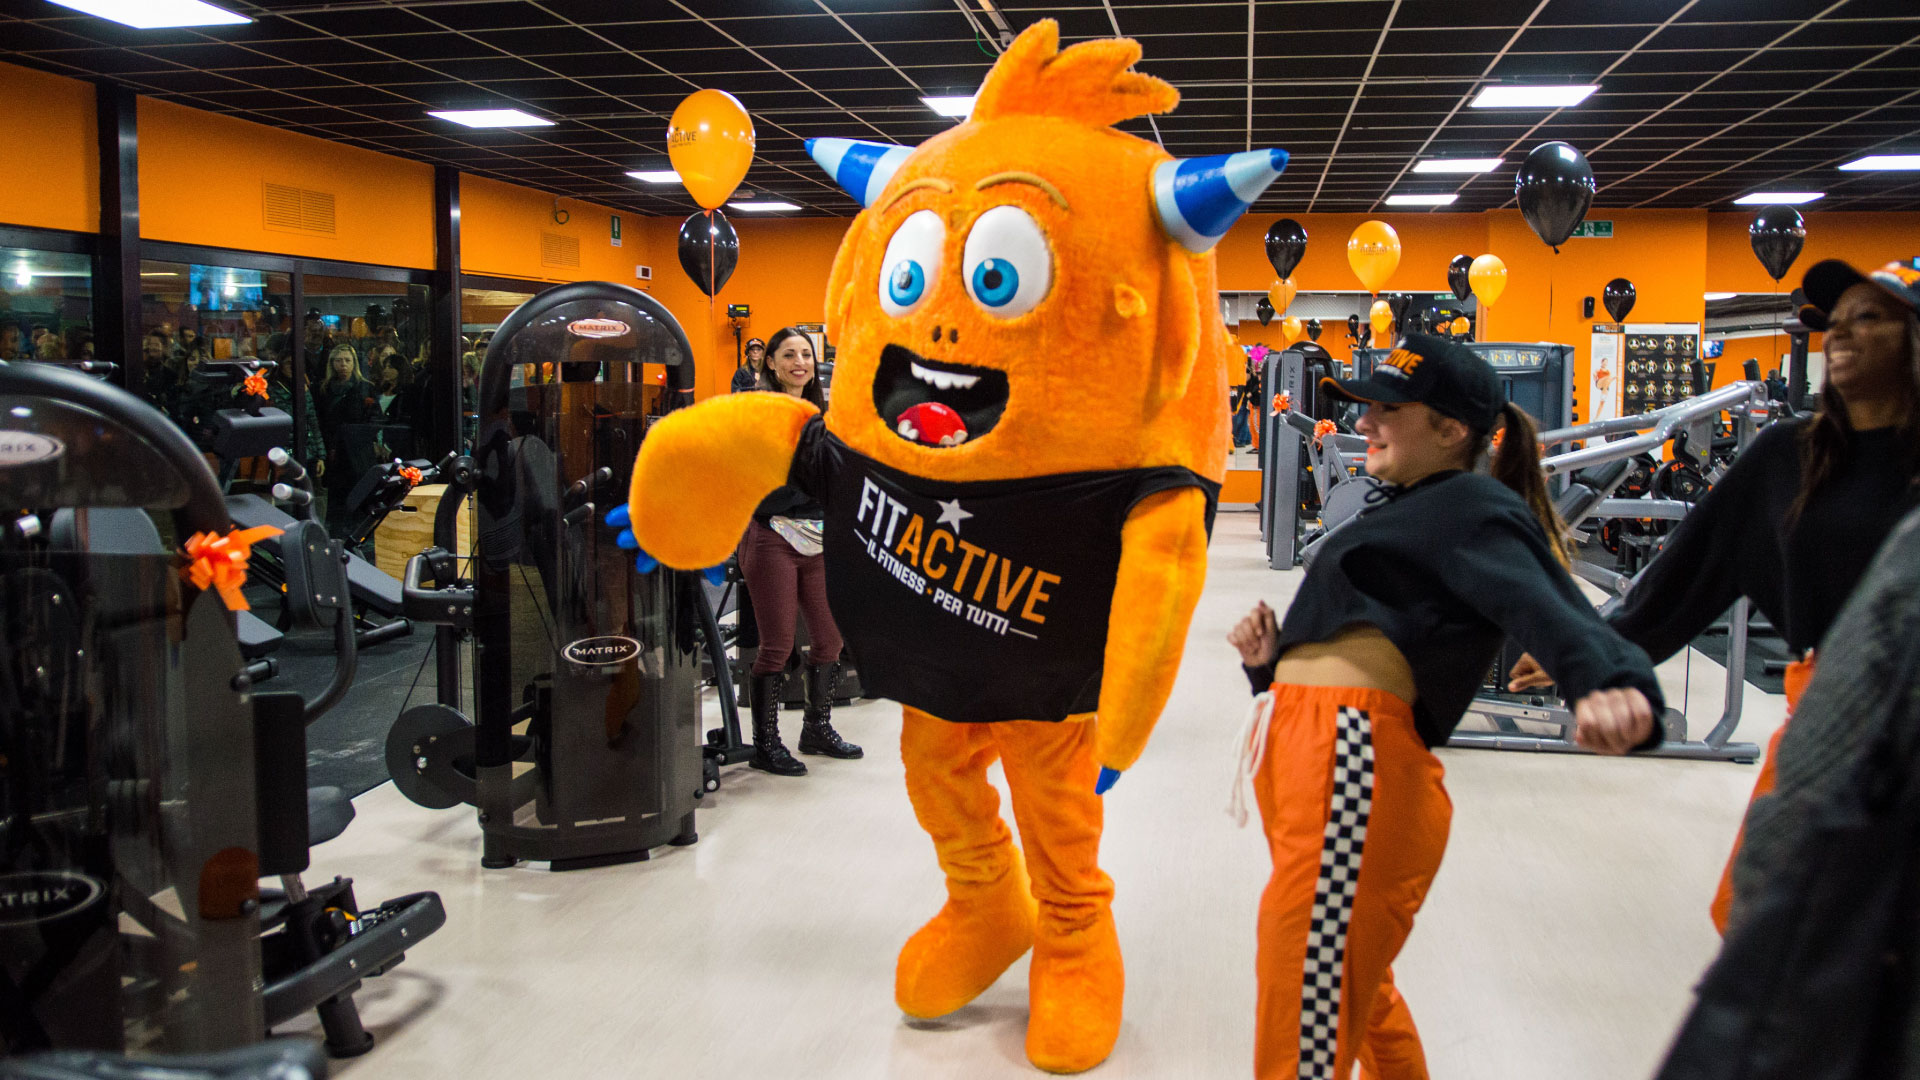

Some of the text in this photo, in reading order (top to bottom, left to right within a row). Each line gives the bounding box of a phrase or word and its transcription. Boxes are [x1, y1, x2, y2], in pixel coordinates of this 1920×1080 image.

[867, 538, 1010, 636] IL FITNESS PER TUTTI
[575, 645, 628, 656] MATRIX
[0, 887, 69, 907] TRIX
